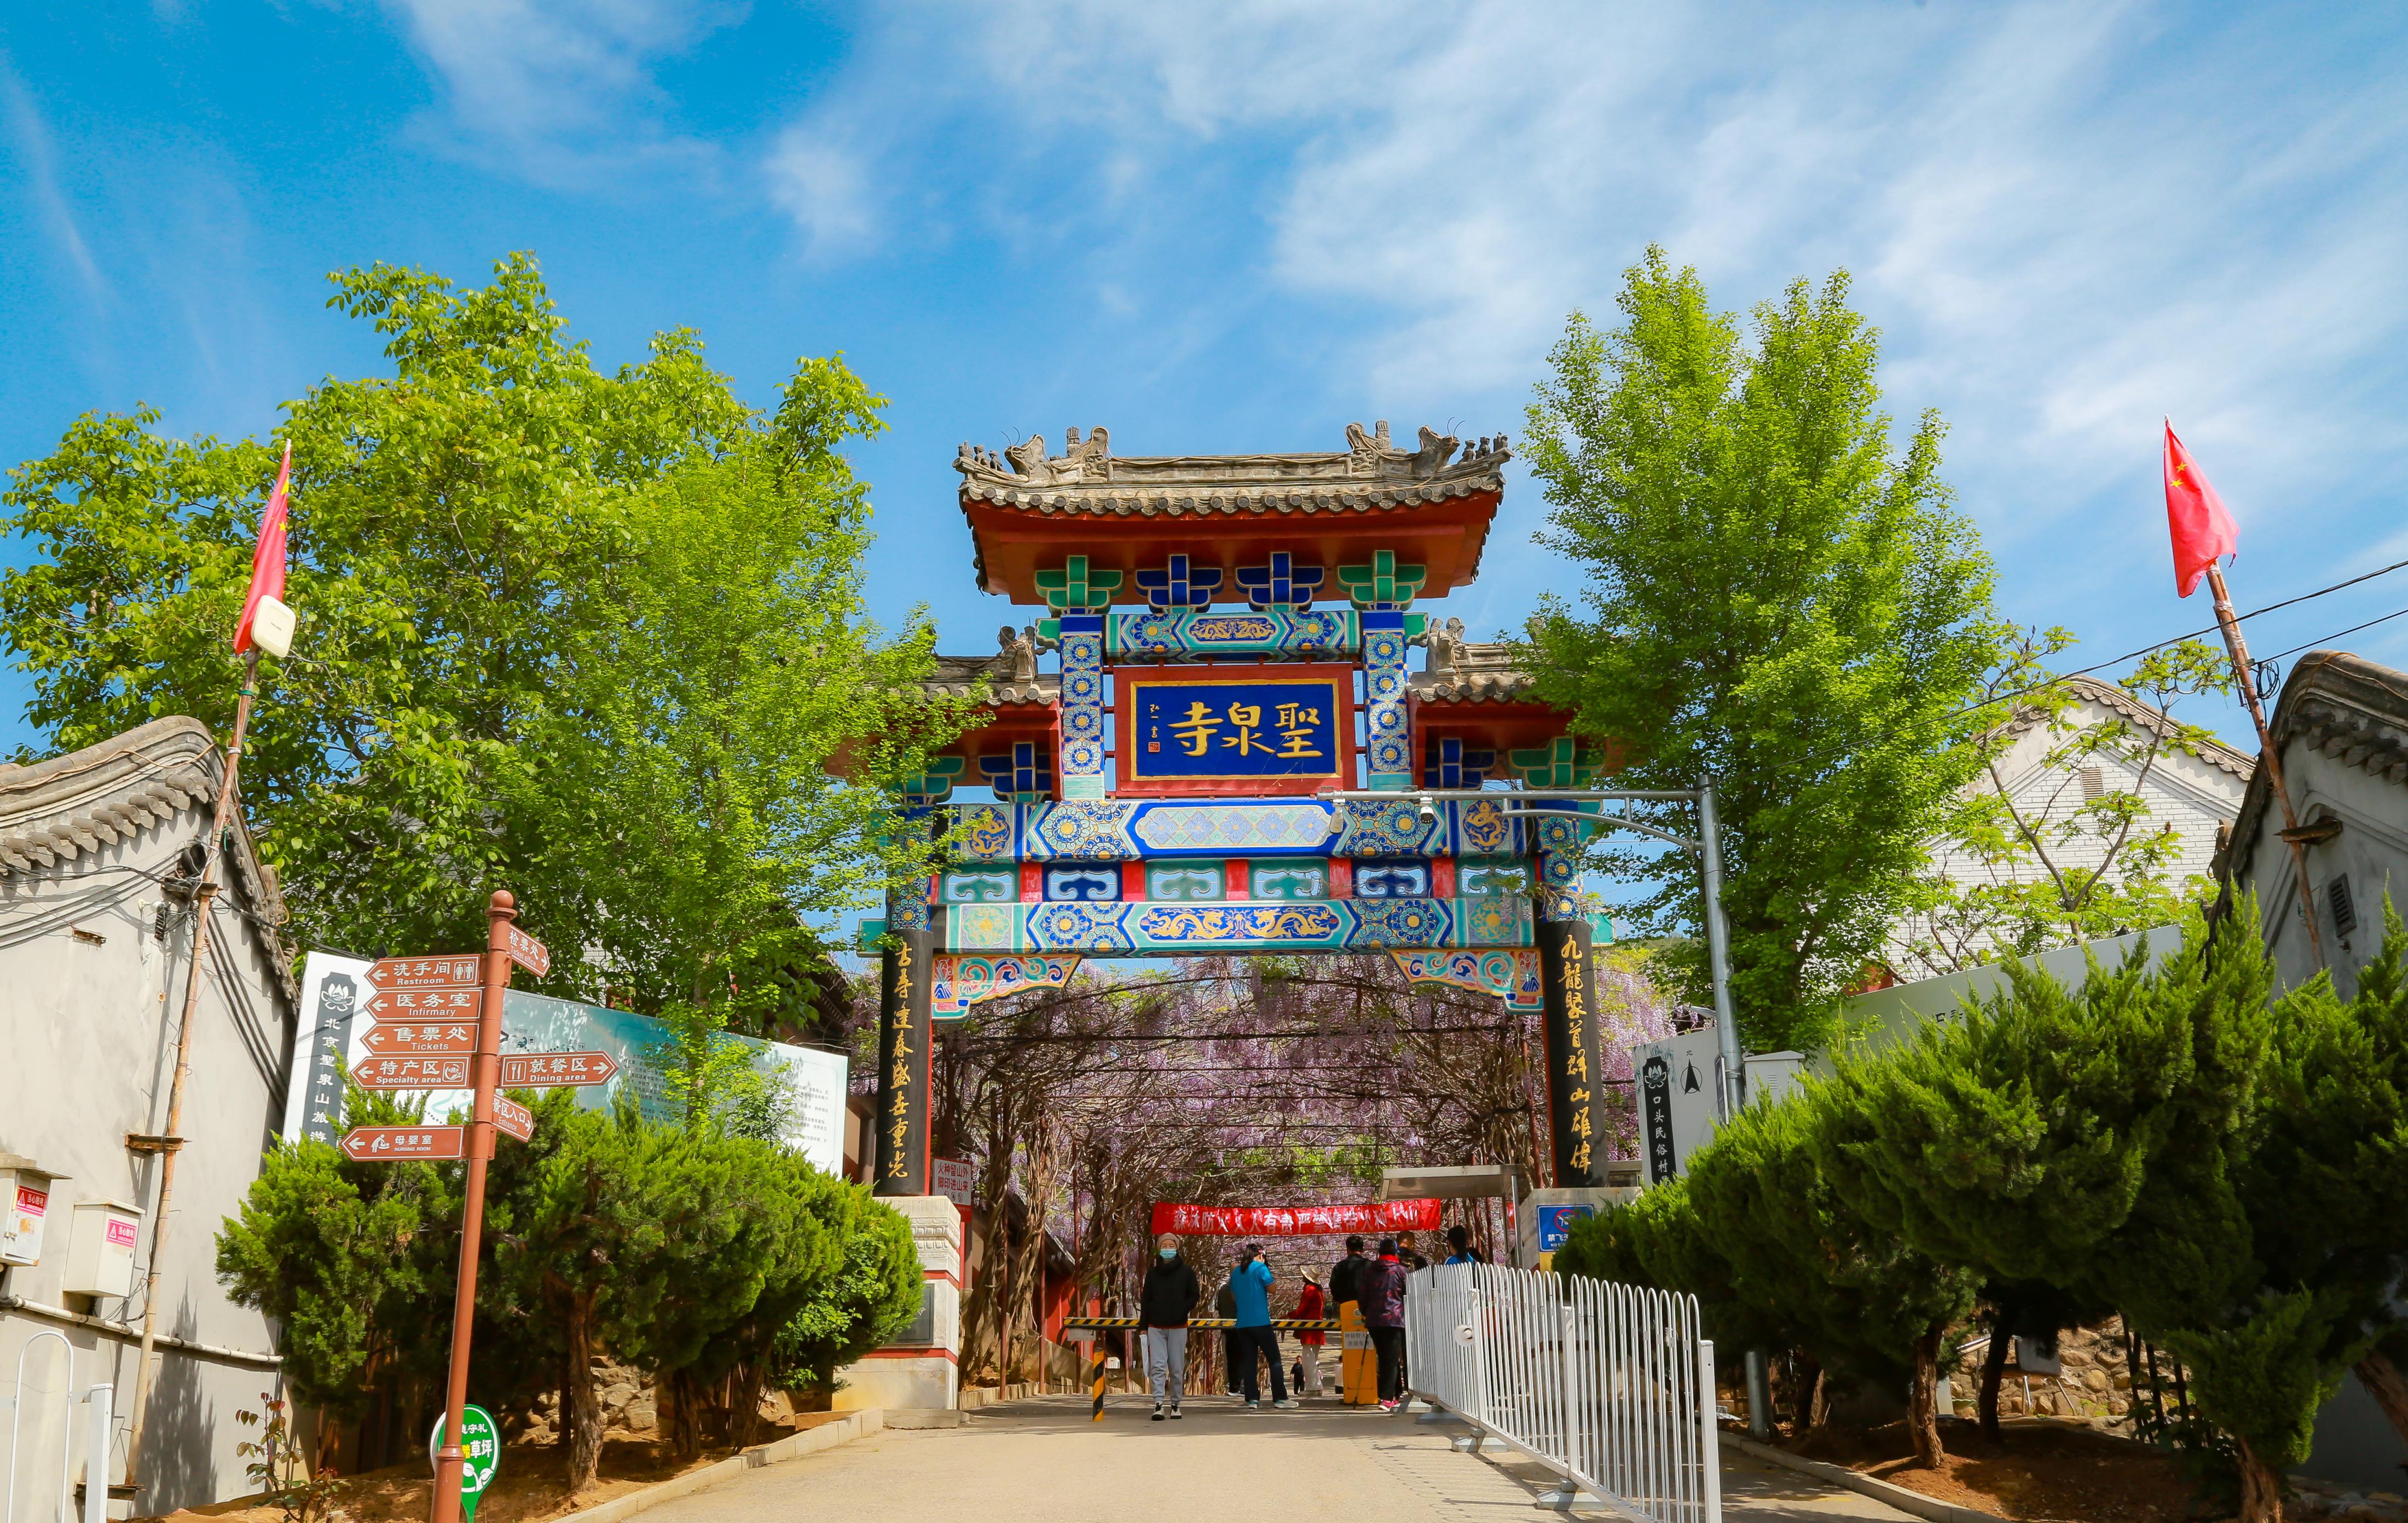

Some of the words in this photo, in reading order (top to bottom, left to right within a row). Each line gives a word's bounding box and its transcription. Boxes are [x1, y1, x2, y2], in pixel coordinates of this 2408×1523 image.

[509, 930, 539, 960] 检票处
[511, 946, 524, 961] Ticket
[525, 955, 536, 967] office
[393, 962, 450, 976] 洗手间
[397, 993, 472, 1007] 医务室
[409, 1008, 455, 1017] Infirmary
[393, 1026, 468, 1042] 售票处
[379, 1060, 440, 1075] 特产区
[530, 1058, 588, 1074] 就餐区
[376, 1076, 419, 1084] Specialty
[530, 1075, 562, 1083] Dining
[493, 1098, 525, 1123] 景区入口
[499, 1116, 517, 1131] Entrance
[395, 1135, 432, 1145] 母婴室
[938, 1162, 969, 1179] 火种留山外
[937, 1176, 968, 1192] 脚印进山来
